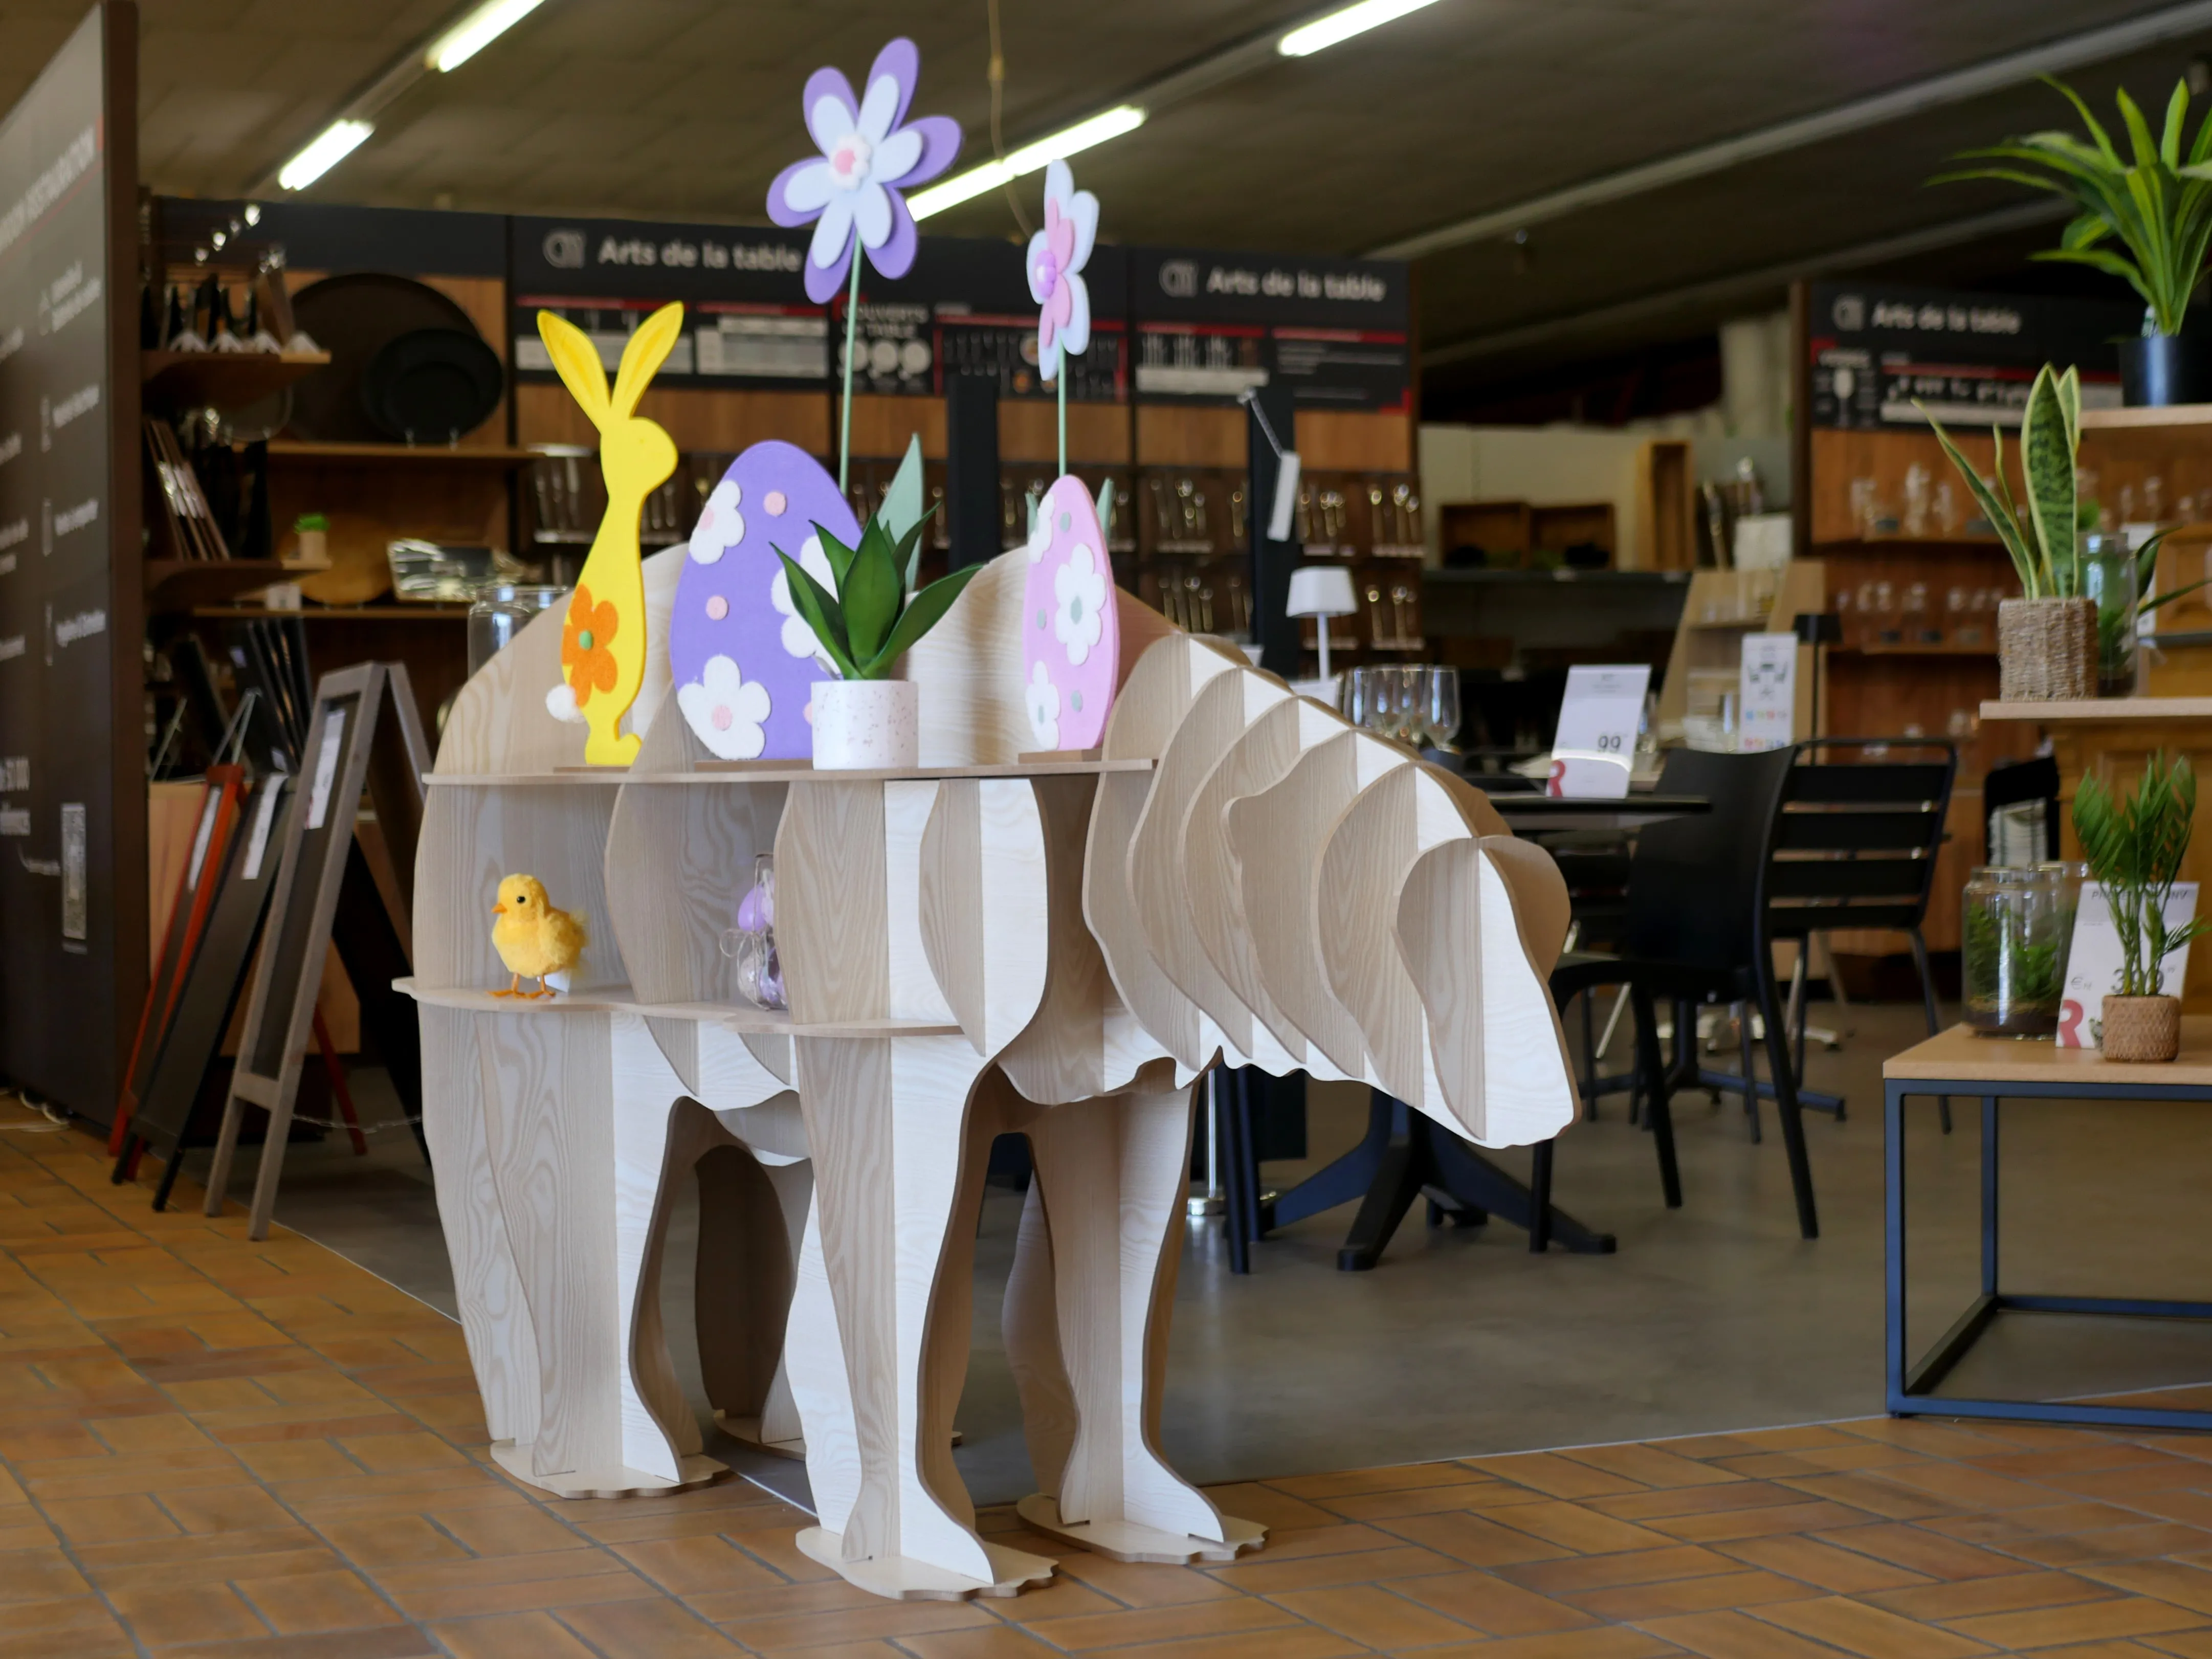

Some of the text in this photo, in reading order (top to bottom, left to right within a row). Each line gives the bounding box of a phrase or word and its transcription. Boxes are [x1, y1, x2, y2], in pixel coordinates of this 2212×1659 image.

[599, 237, 802, 272] Arts de la table
[1207, 267, 1386, 302] Arts de la table
[1872, 302, 2021, 334] Arts de la table
[1598, 735, 1621, 752] 99
